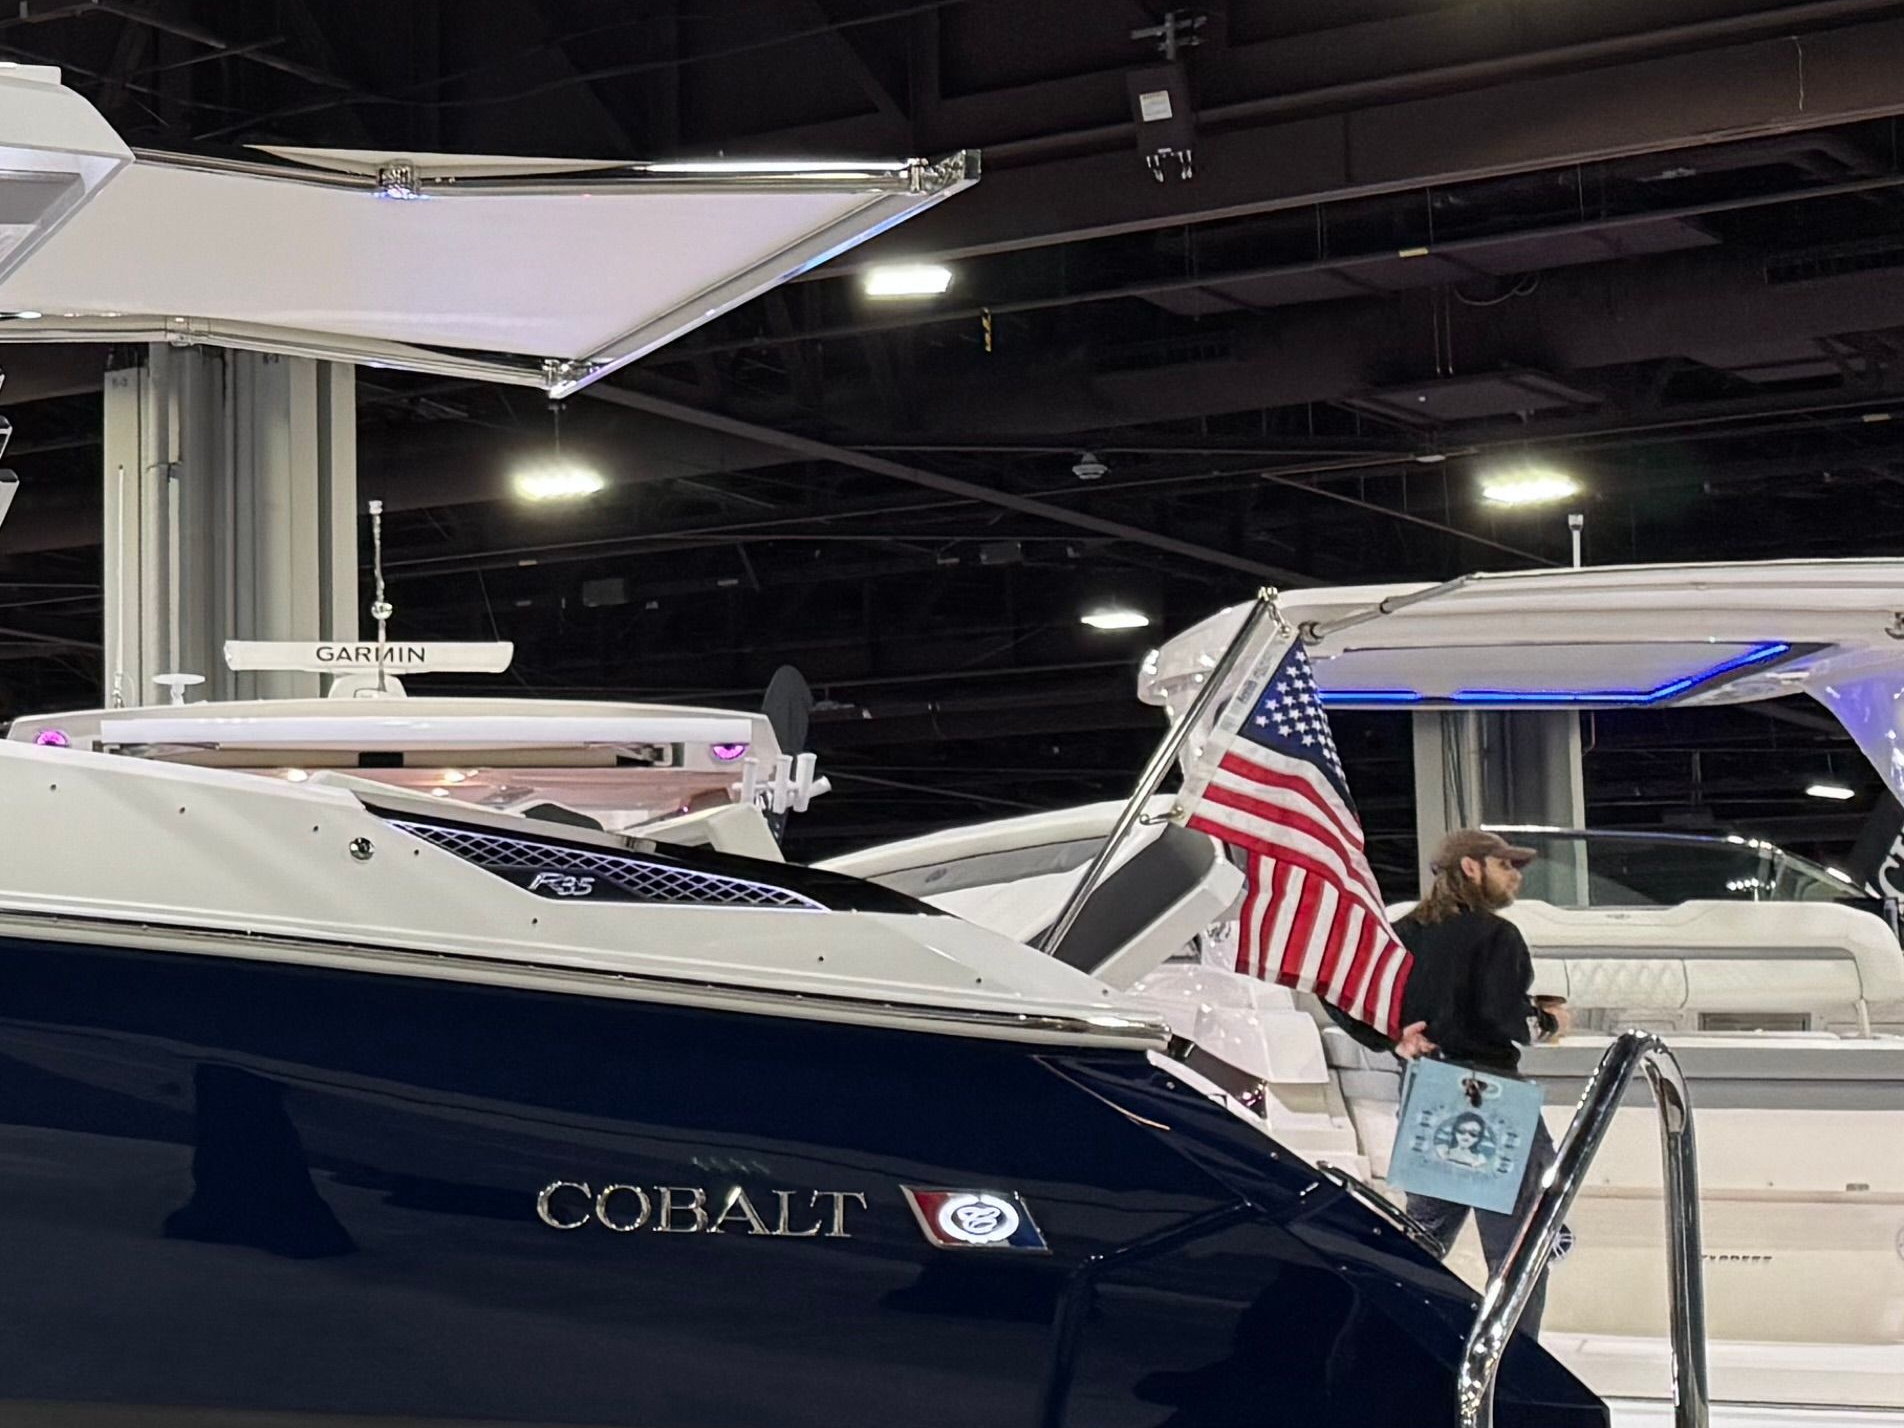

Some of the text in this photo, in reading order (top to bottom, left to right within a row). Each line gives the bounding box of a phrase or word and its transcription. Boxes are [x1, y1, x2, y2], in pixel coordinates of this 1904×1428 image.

[315, 645, 426, 663] GARMIN
[528, 871, 596, 896] R35
[536, 1180, 869, 1237] COBALT
